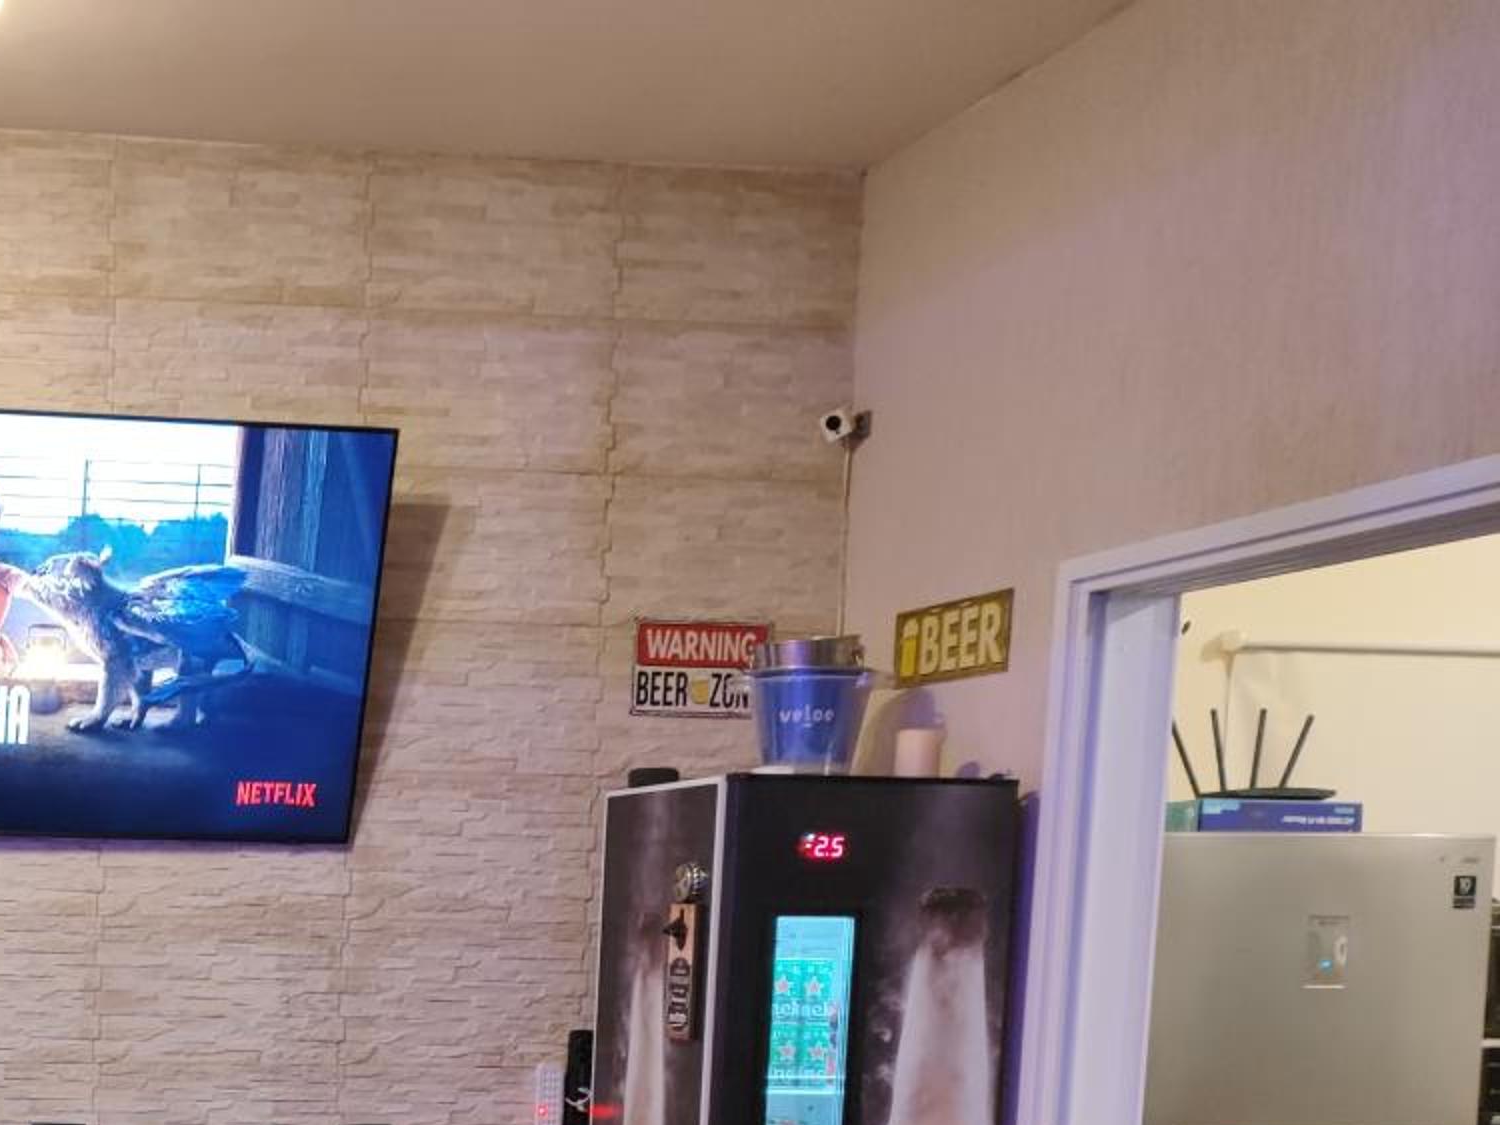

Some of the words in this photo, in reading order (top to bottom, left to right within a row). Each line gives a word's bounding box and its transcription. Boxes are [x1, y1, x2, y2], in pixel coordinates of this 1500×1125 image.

[919, 601, 1003, 675] BEER
[636, 671, 689, 707] BEER
[236, 781, 317, 807] NETFLIX
